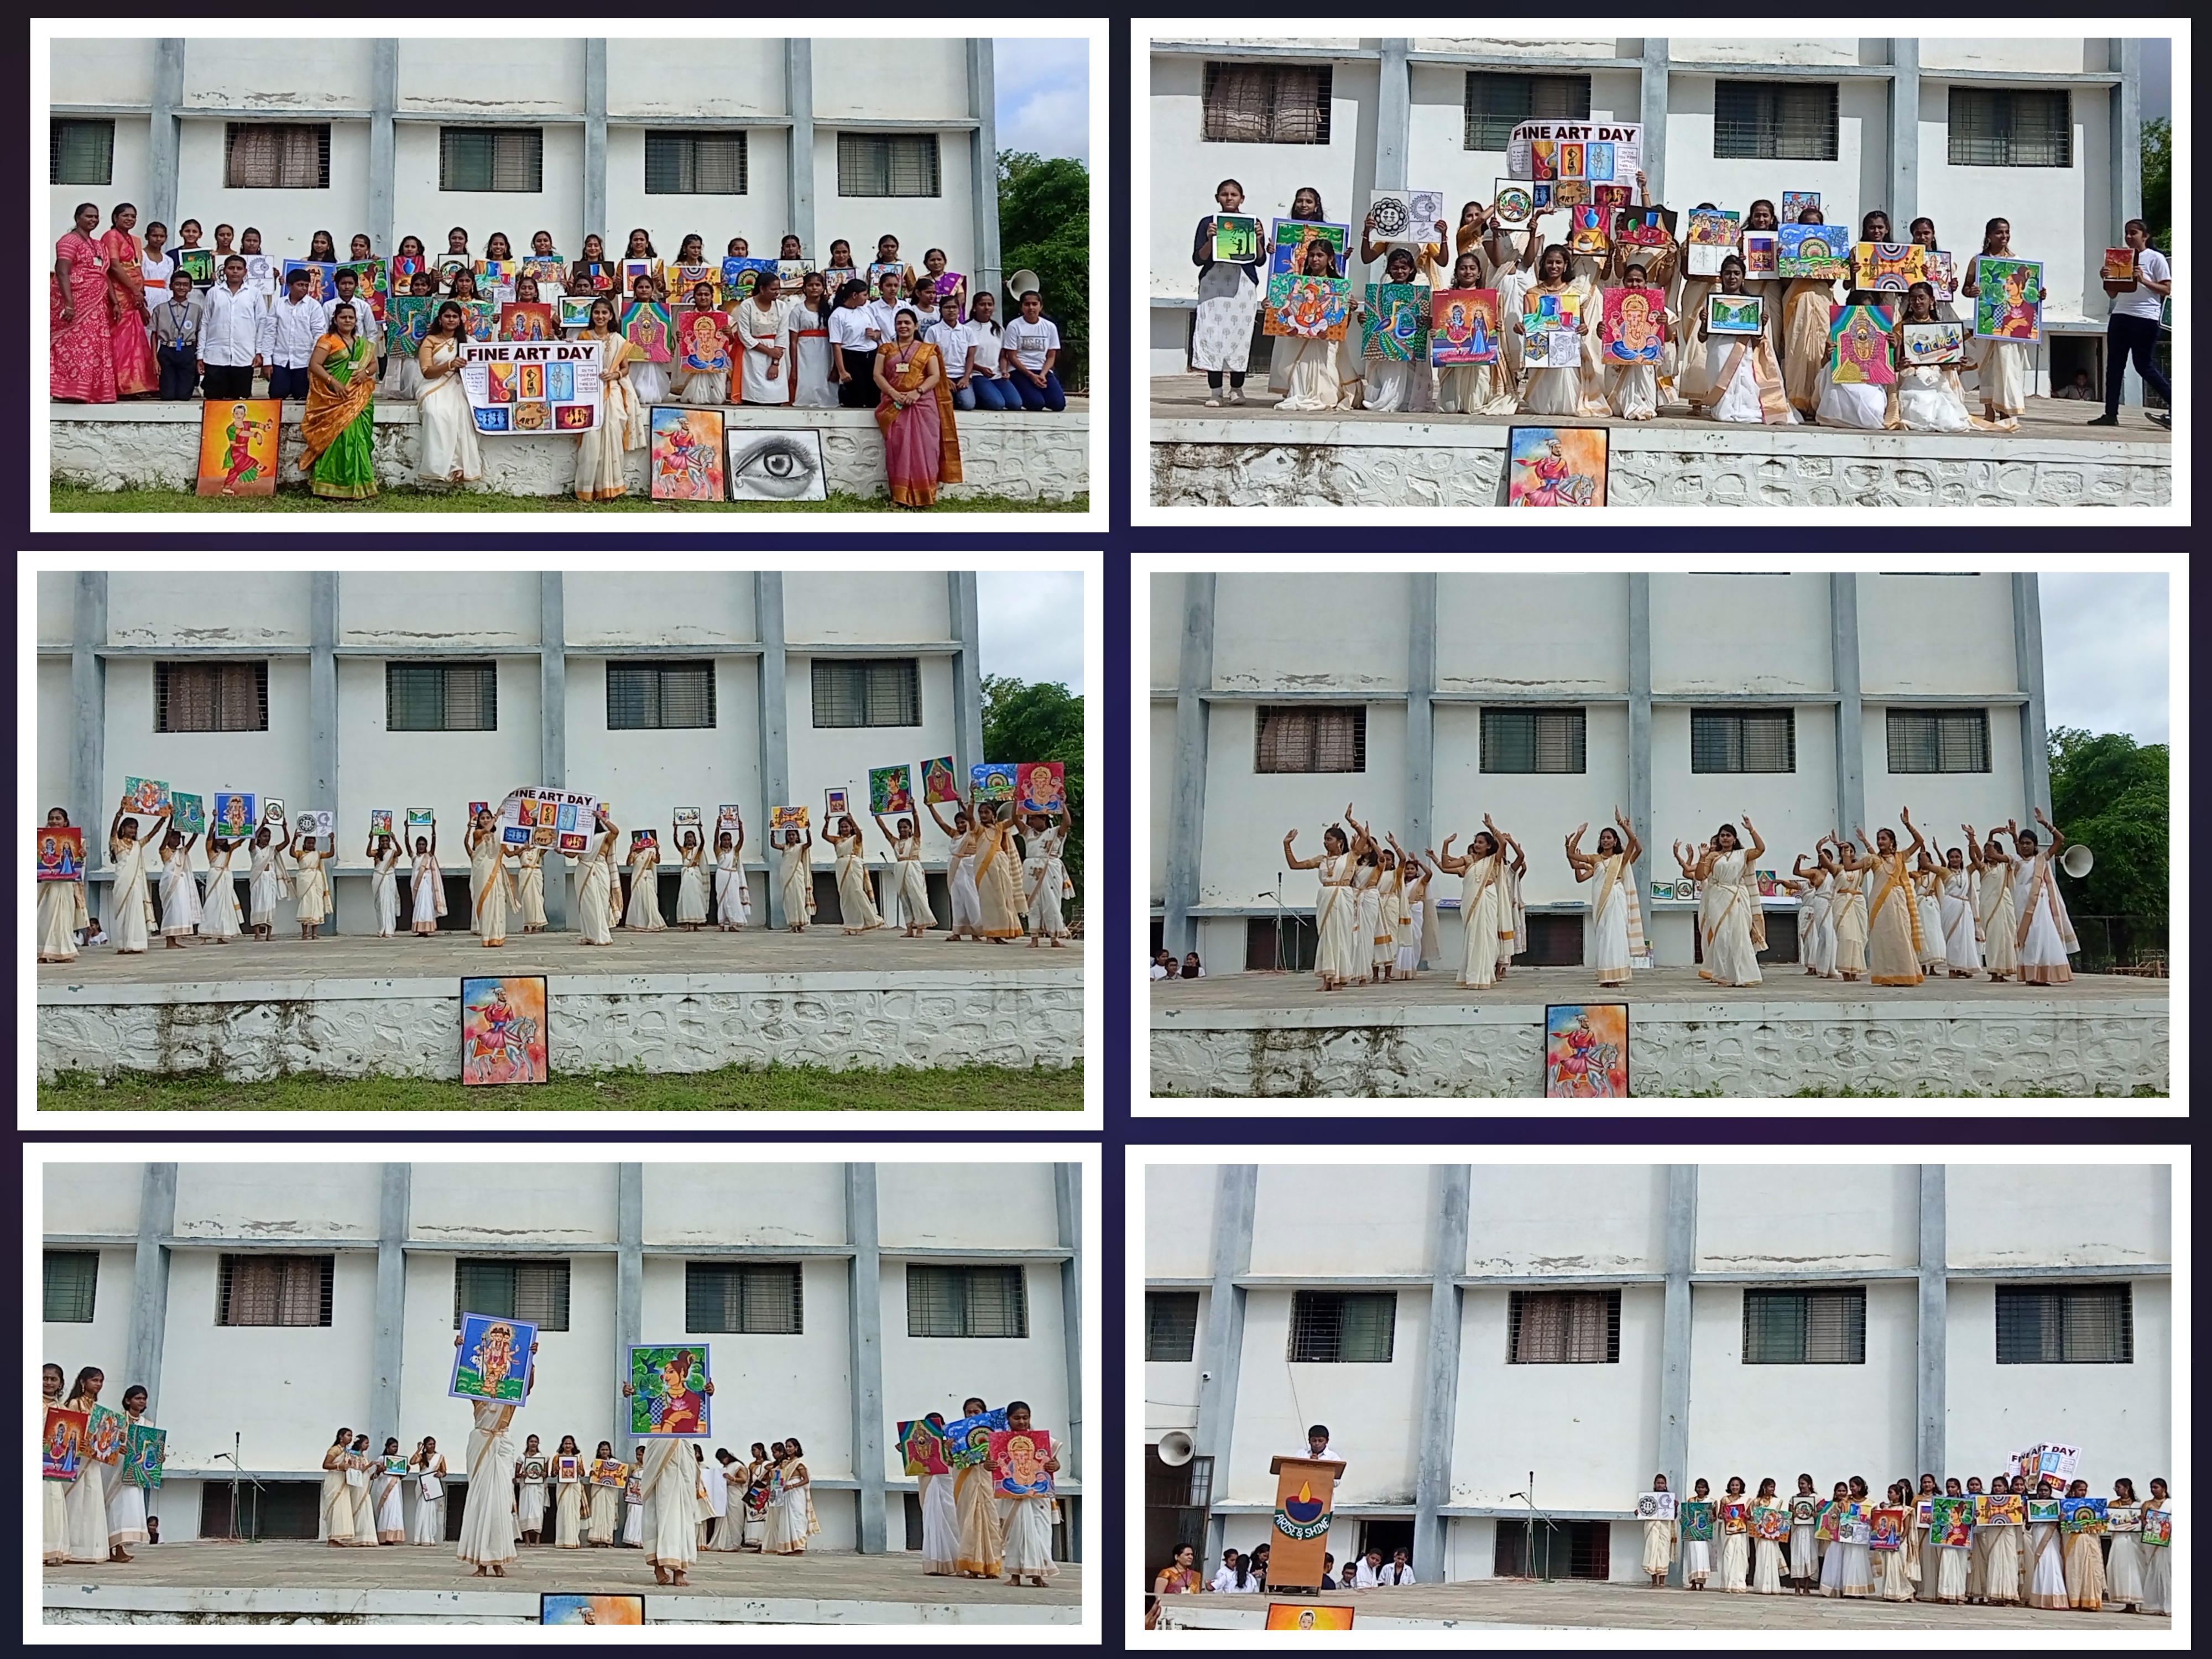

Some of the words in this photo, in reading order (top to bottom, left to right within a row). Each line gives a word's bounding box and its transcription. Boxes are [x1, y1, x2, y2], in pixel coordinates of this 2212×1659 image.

[1513, 126, 1551, 140] FINE
[1555, 126, 1593, 140] ART
[1598, 128, 1636, 142] DAY
[1911, 329, 1959, 356] Cricket
[467, 348, 509, 361] FINE
[513, 347, 551, 361] ART
[557, 347, 594, 360] DAY
[519, 417, 535, 425] ART
[538, 791, 564, 802] ART
[567, 795, 593, 806] DAY
[2052, 1446, 2076, 1457] DAY
[1305, 1516, 1330, 1538] SHINE
